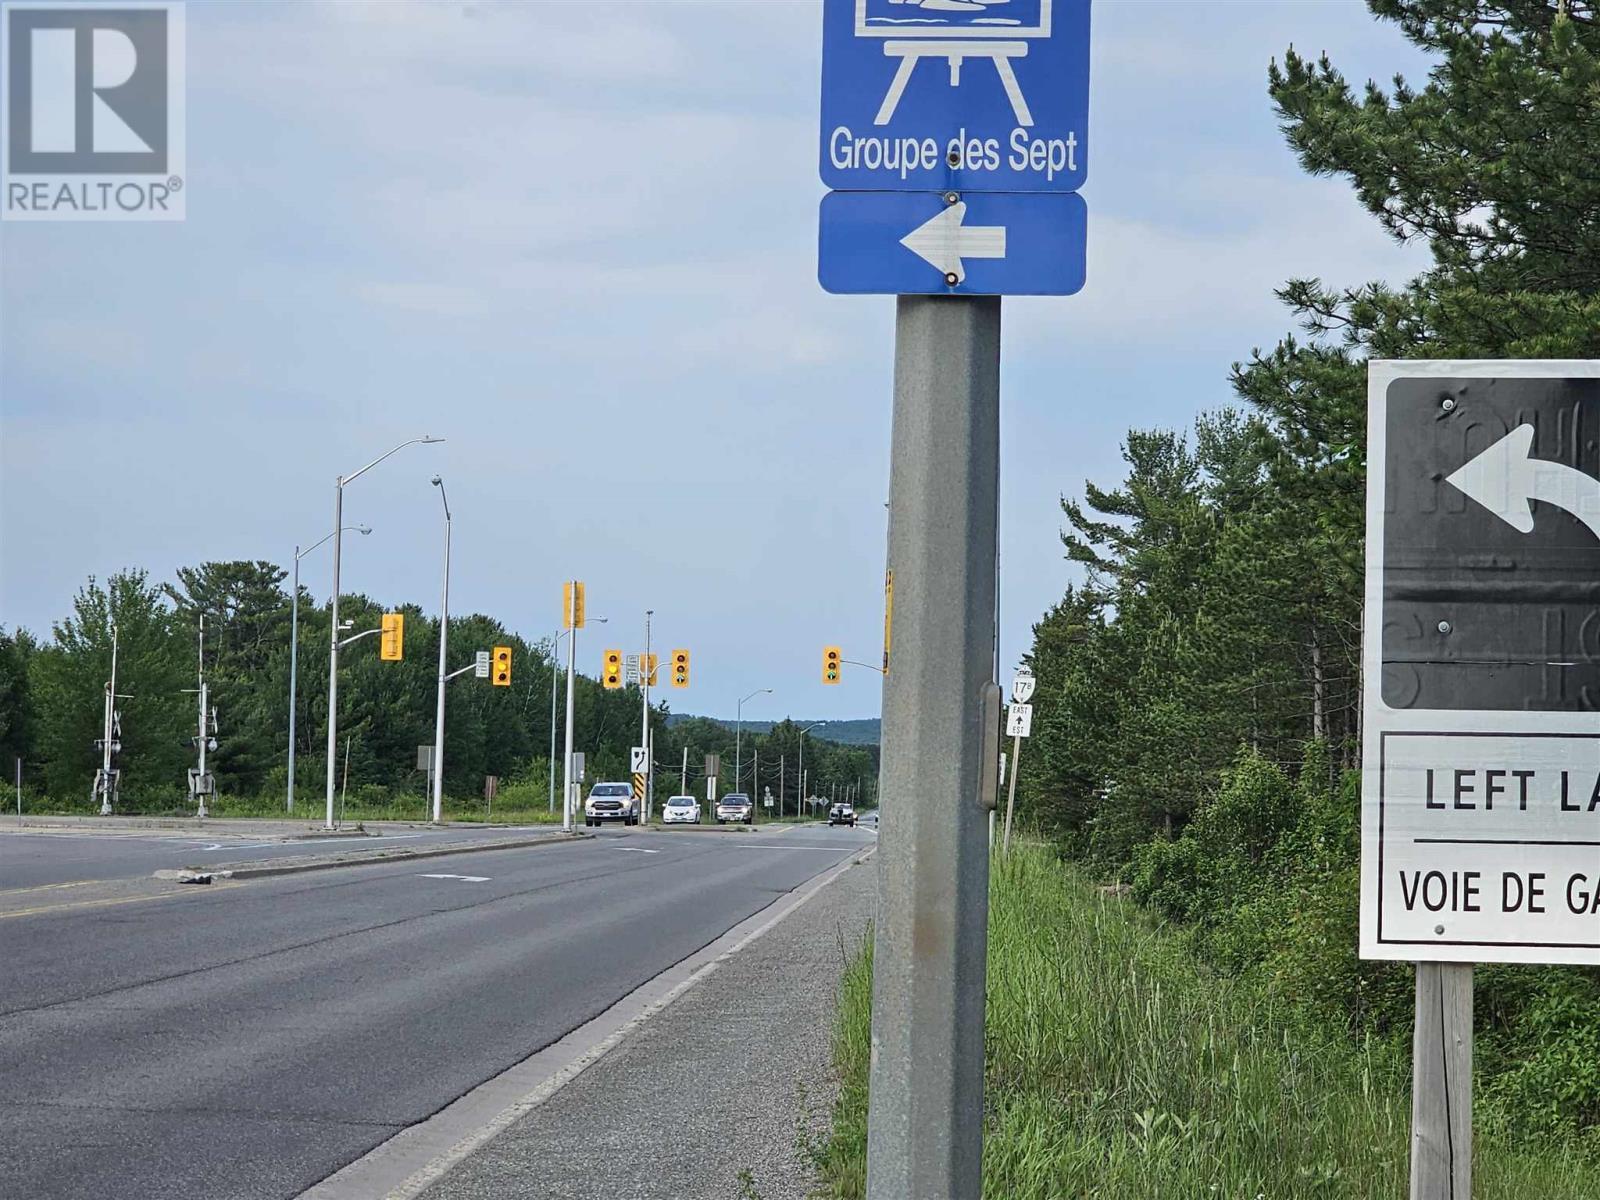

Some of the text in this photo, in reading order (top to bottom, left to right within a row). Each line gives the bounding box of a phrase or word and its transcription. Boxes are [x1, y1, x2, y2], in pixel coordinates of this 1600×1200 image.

[830, 126, 1077, 182] Groupe des Sept
[1012, 705, 1028, 715] EAST
[1012, 726, 1024, 735] EST
[1426, 769, 1535, 811] LEFT
[1399, 870, 1481, 913] VOIE
[1502, 873, 1546, 914] DE
